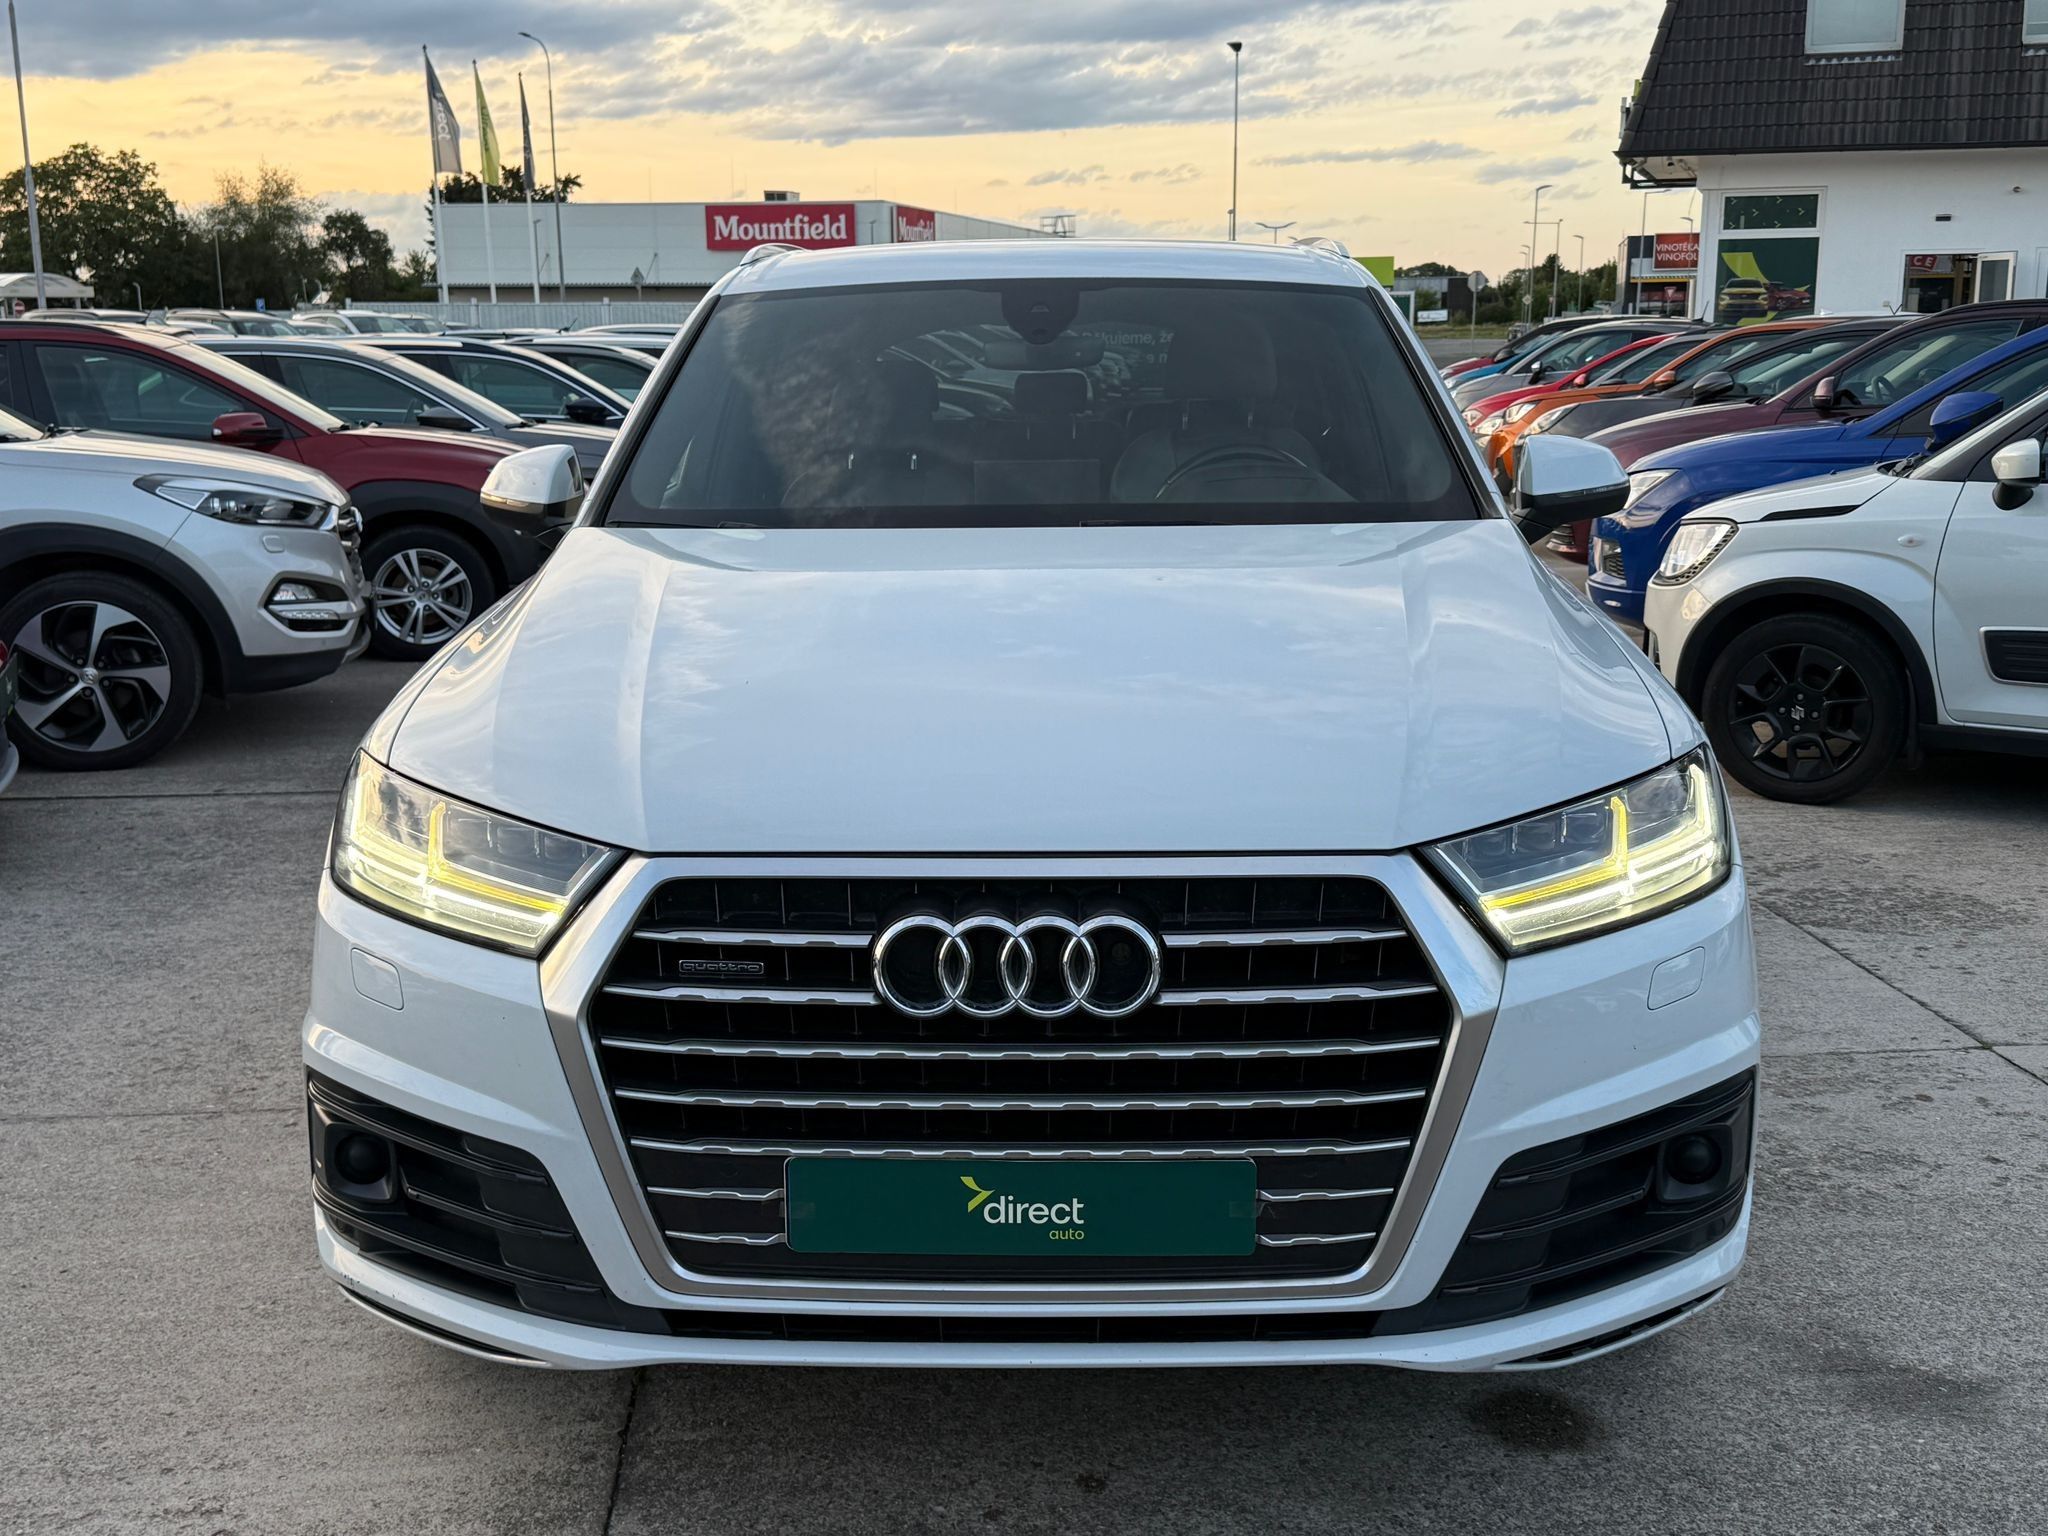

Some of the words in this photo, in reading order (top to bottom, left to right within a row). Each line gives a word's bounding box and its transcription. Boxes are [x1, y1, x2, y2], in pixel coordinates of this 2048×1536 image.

[713, 214, 847, 241] Mountfield
[1656, 242, 1699, 252] VINOTÉKA
[683, 962, 760, 972] quattro
[983, 1195, 1084, 1224] direct
[1049, 1228, 1085, 1240] auto
